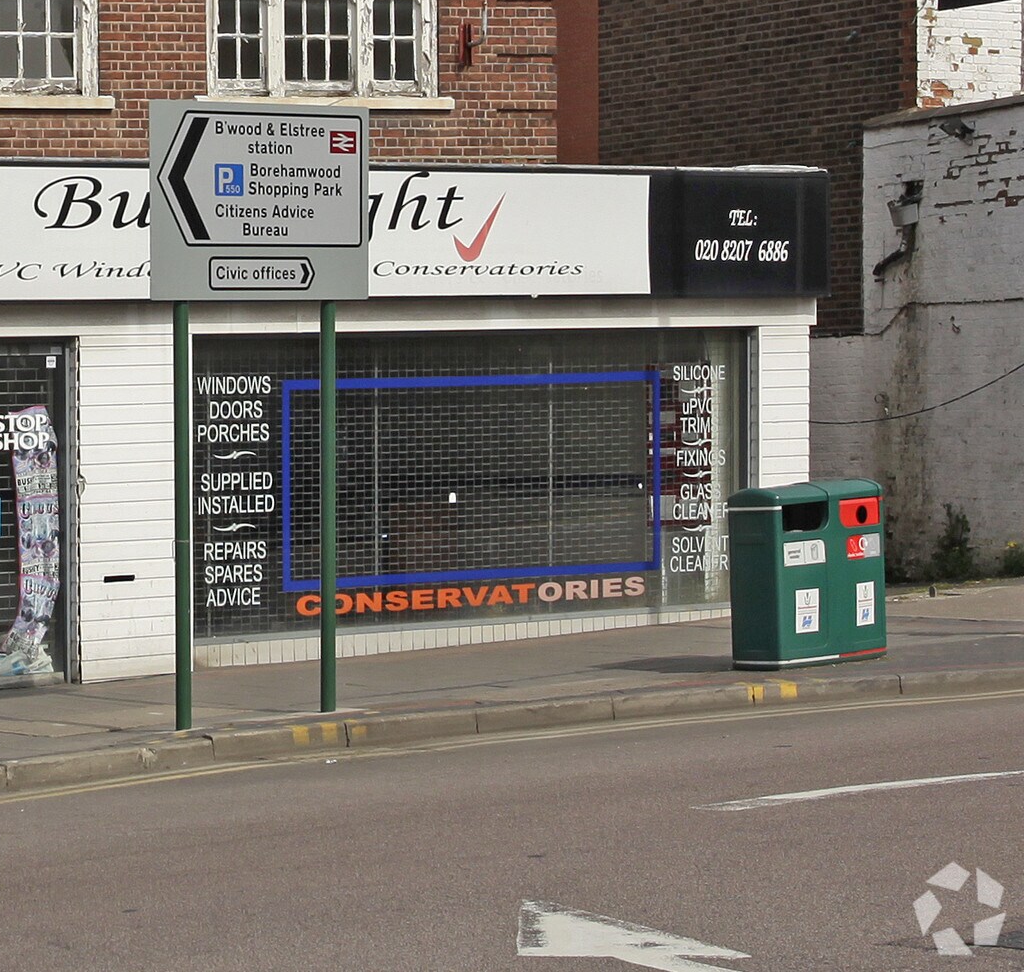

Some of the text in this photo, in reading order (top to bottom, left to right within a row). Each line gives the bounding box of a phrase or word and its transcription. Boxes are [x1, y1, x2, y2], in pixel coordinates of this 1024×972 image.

[215, 120, 325, 137] B'wood & Elstree
[248, 141, 293, 155] station
[250, 163, 341, 178] Borehamwood
[225, 184, 241, 193] 550
[248, 182, 342, 198] Shopping Park
[215, 203, 315, 219] Citizens Advice
[728, 209, 757, 226] TEL:
[243, 223, 289, 236] Bureau
[695, 239, 790, 262] 020 8207 6886
[216, 266, 296, 280] Civic offices
[373, 260, 584, 277] Conservatories
[673, 365, 726, 381] SILICONE
[197, 375, 272, 395] WINDOWS
[209, 400, 264, 420] DOORS
[197, 423, 270, 443] PORCHES
[676, 448, 726, 466] FIXINGS
[200, 472, 273, 492] SUPPLIED
[680, 483, 721, 500] GLASS
[197, 494, 275, 515] INSTALLED
[203, 540, 267, 561] REPAIRS
[672, 535, 729, 554] SOLVENT
[670, 554, 729, 573] CLEANER
[204, 564, 263, 584] SPARES
[206, 587, 261, 607] ADVICE
